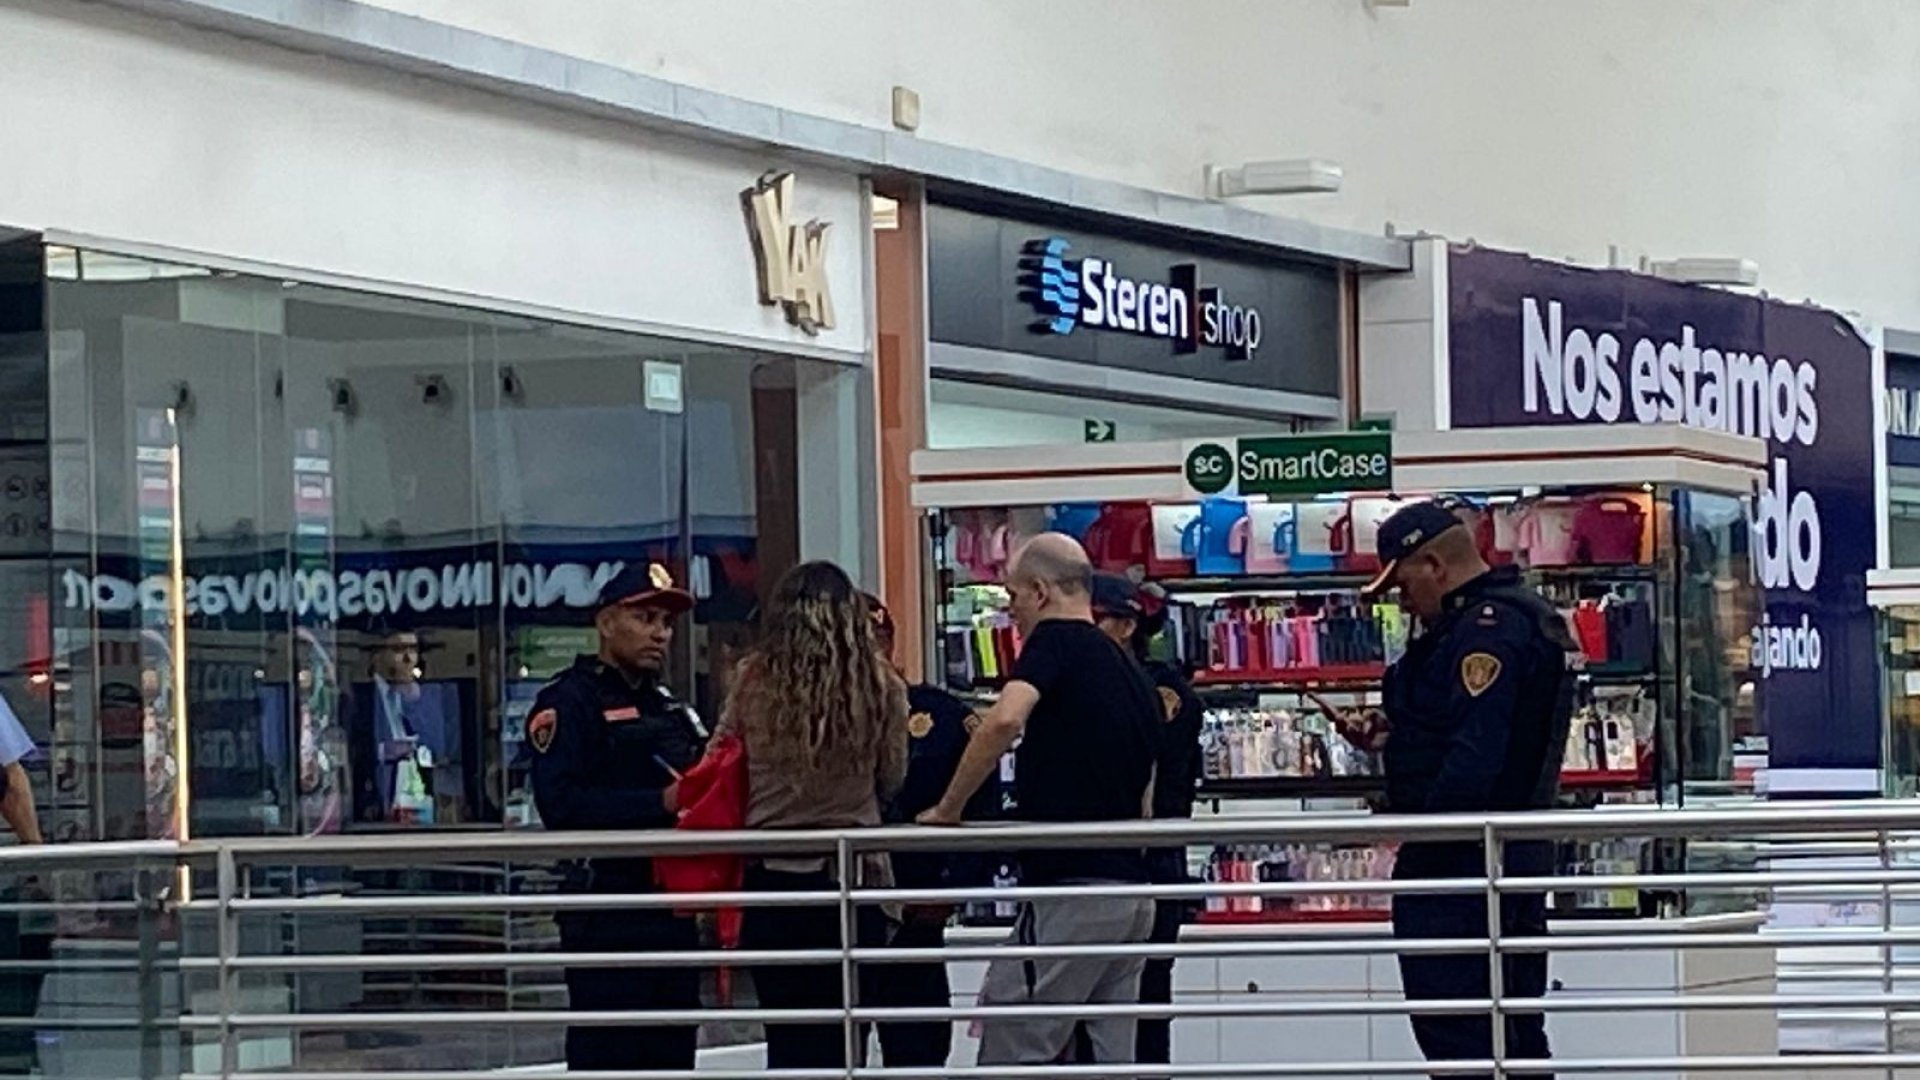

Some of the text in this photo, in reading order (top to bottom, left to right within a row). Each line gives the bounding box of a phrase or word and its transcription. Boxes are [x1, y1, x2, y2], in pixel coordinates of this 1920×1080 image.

[1082, 257, 1261, 360] Steren shop
[1521, 298, 1819, 446] Nos estamos
[1240, 448, 1388, 481] SmartCase
[1756, 457, 1822, 592] do
[1751, 613, 1822, 678] ajando
